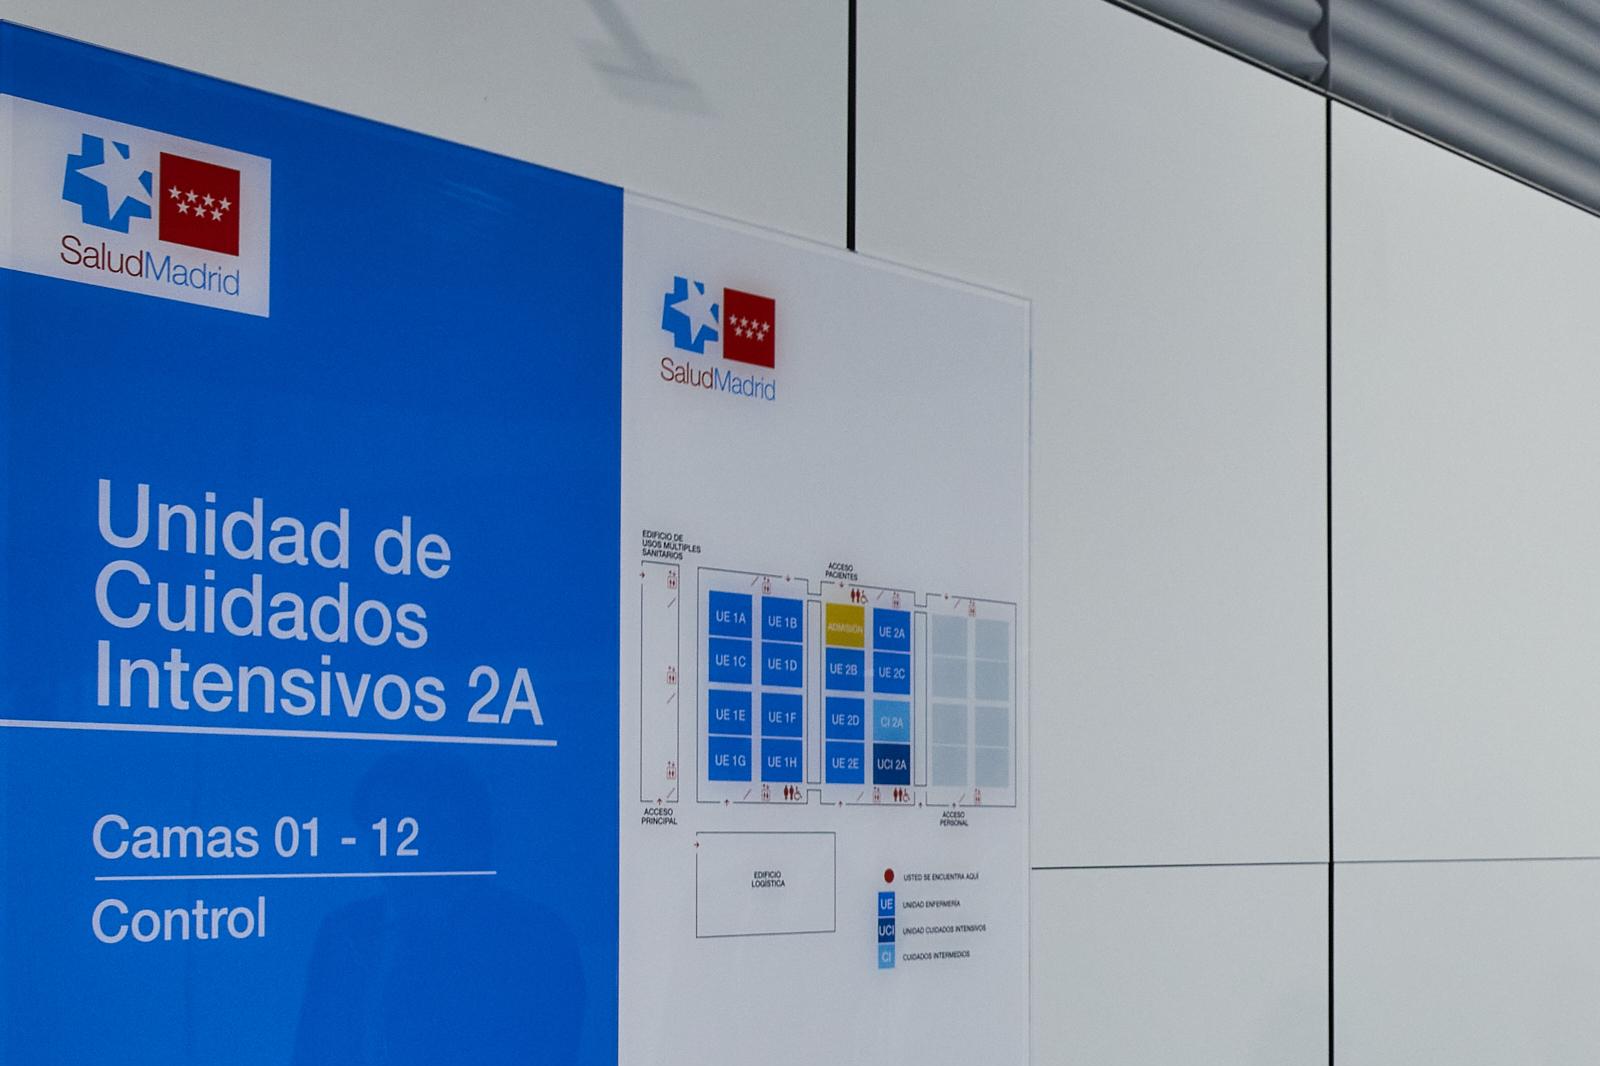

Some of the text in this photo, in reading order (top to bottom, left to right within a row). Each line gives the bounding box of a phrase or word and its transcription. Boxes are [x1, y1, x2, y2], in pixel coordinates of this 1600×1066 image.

[60, 234, 241, 297] SaludMadrid
[660, 357, 776, 400] SaludMadrid
[98, 478, 452, 579] Unidad de
[642, 530, 683, 542] EDIFICIO DE
[642, 539, 662, 548] USOS
[642, 548, 683, 560] SANITARIOS
[829, 562, 853, 572] ACCESO
[825, 570, 858, 581] PACIENTES
[95, 560, 428, 649] Cuidados
[715, 611, 746, 625] UE 1A
[768, 616, 798, 629] UE 1B
[879, 626, 905, 639] UE 2A
[715, 655, 746, 667] UE 1C
[768, 658, 798, 671] UE 1D
[830, 663, 857, 675] UE 2B
[879, 666, 905, 679] UE 2C
[96, 640, 544, 726] Intensivos 2A
[716, 709, 746, 721] UE 1E
[768, 711, 797, 723] UE 1F
[832, 714, 860, 726] UE 2D
[881, 717, 904, 729] CI 2A
[715, 755, 746, 767] UE 1G
[768, 756, 797, 768] UE 1H
[832, 758, 859, 769] UE 2E
[877, 758, 907, 770] UCI 2A
[644, 808, 673, 816] ACCESO
[940, 819, 968, 827] PERSONAL
[92, 814, 259, 860] Camas
[274, 816, 318, 857] 01
[373, 817, 419, 857] 12
[754, 871, 781, 879] EDIFICIO
[880, 898, 893, 910] UE
[92, 896, 266, 944] Control
[879, 925, 894, 936] UCI
[903, 924, 986, 935] UNIDAD CUIDADOS INTENSIVOS
[882, 952, 891, 962] CI
[903, 951, 970, 961] CUIDADOS INTERMEDIOS
